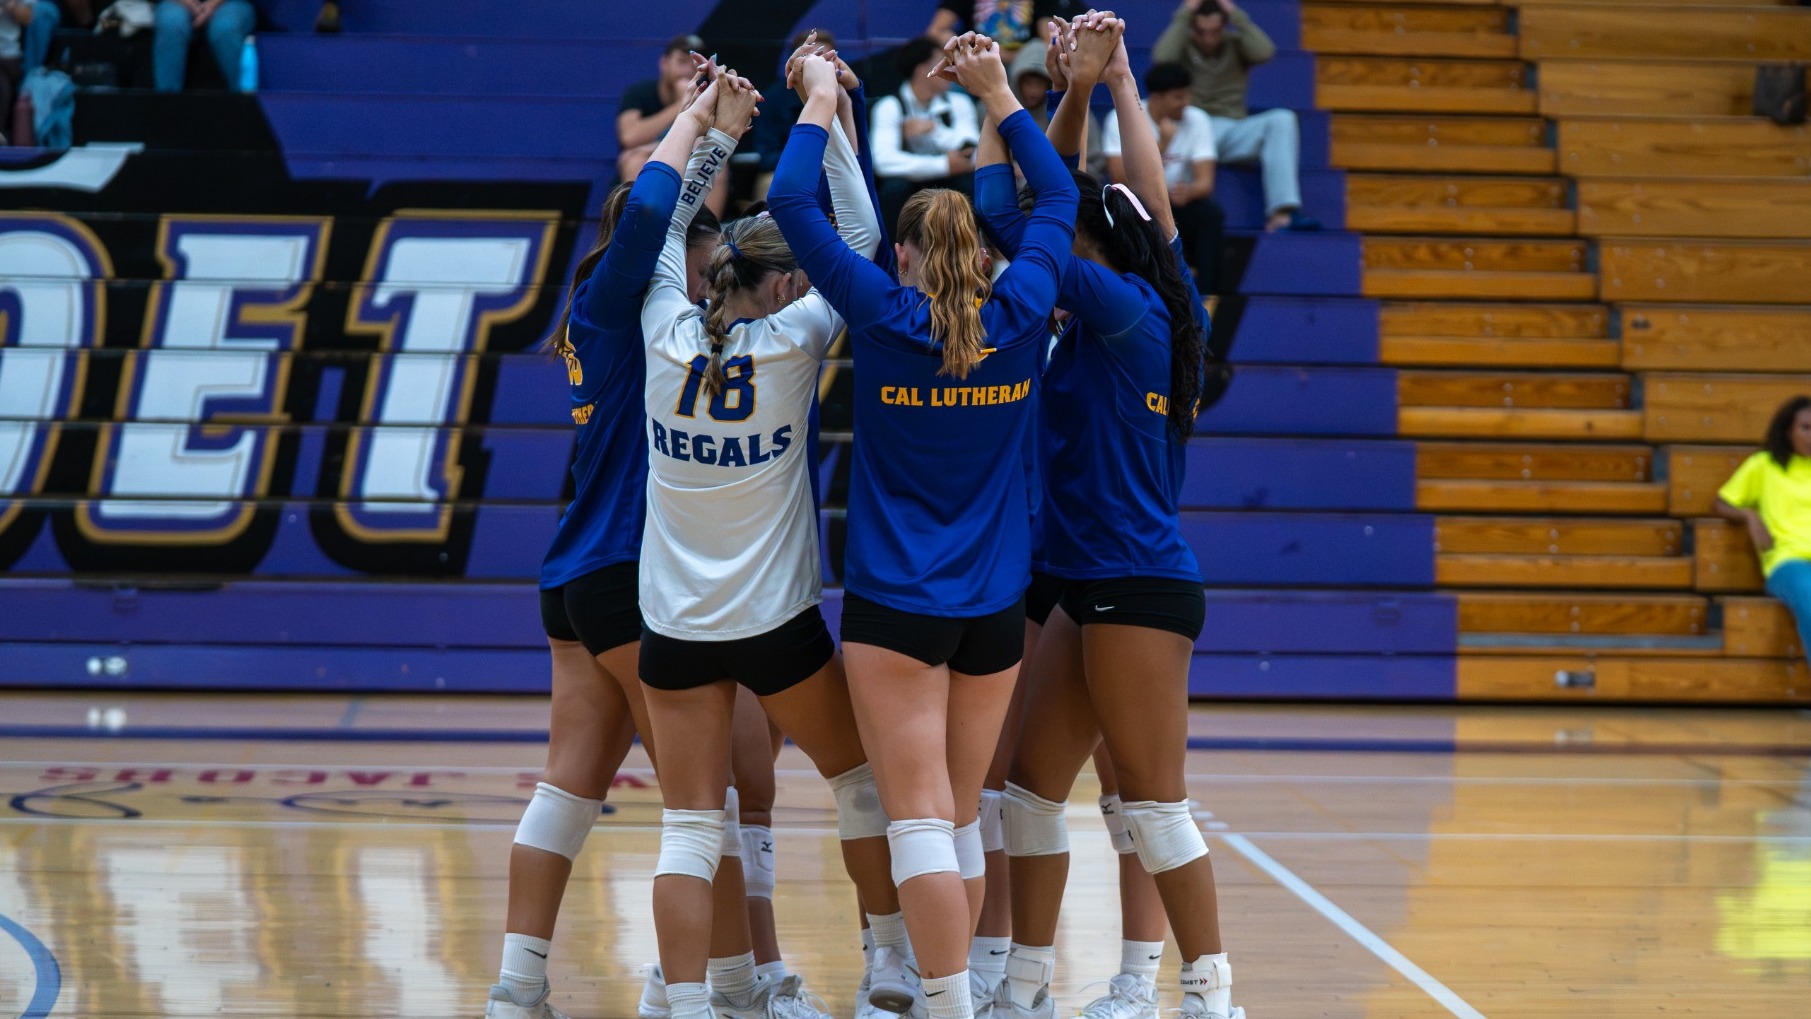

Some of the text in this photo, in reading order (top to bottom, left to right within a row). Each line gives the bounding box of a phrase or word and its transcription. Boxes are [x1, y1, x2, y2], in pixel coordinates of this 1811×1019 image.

[680, 147, 728, 206] BELIEVE
[673, 352, 758, 424] 18
[880, 377, 1031, 407] CAL LUTHERAN
[651, 417, 793, 468] REGALS
